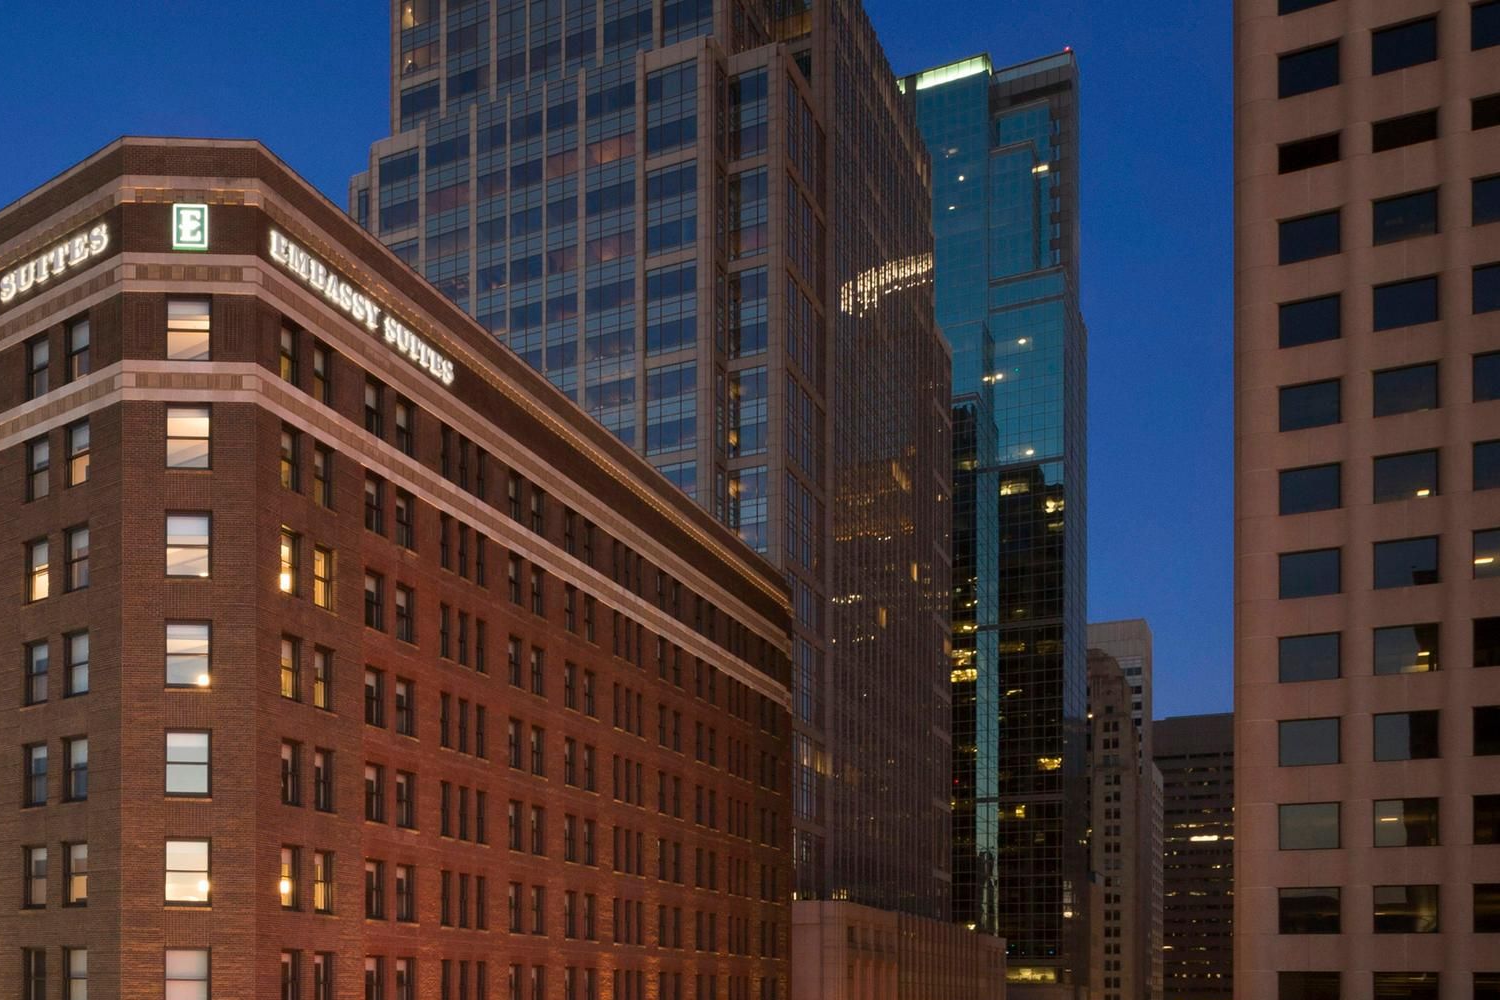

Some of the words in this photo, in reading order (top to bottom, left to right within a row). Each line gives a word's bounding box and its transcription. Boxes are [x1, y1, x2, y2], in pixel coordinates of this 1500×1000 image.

[0, 223, 109, 302] SUITES
[179, 209, 202, 242] E
[269, 229, 382, 331] EMBASSY
[384, 316, 455, 386] SUITES
